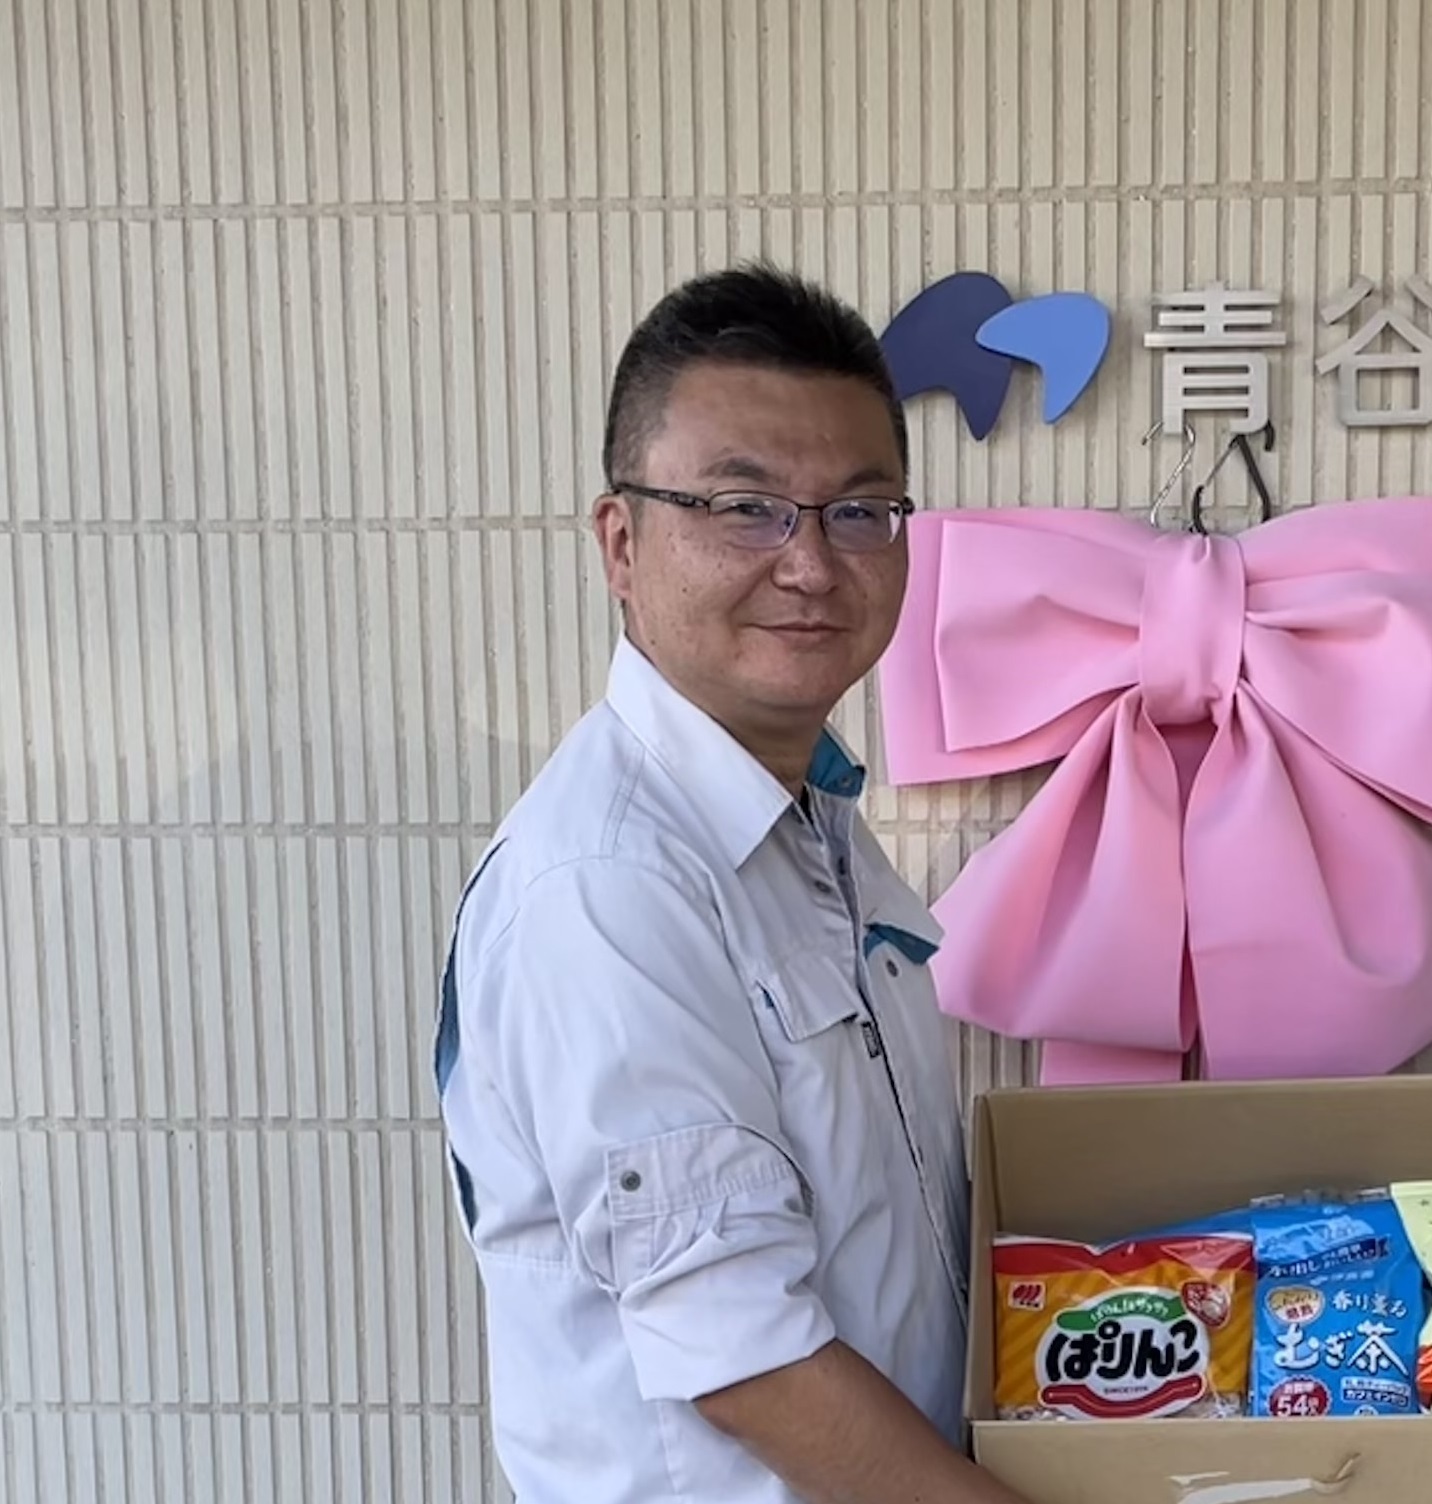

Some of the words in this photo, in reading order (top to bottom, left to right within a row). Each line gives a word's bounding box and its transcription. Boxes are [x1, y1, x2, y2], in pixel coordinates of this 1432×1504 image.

[1046, 1320, 1200, 1382] ぱりんこ
[1273, 1319, 1410, 1376] むぎ茶
